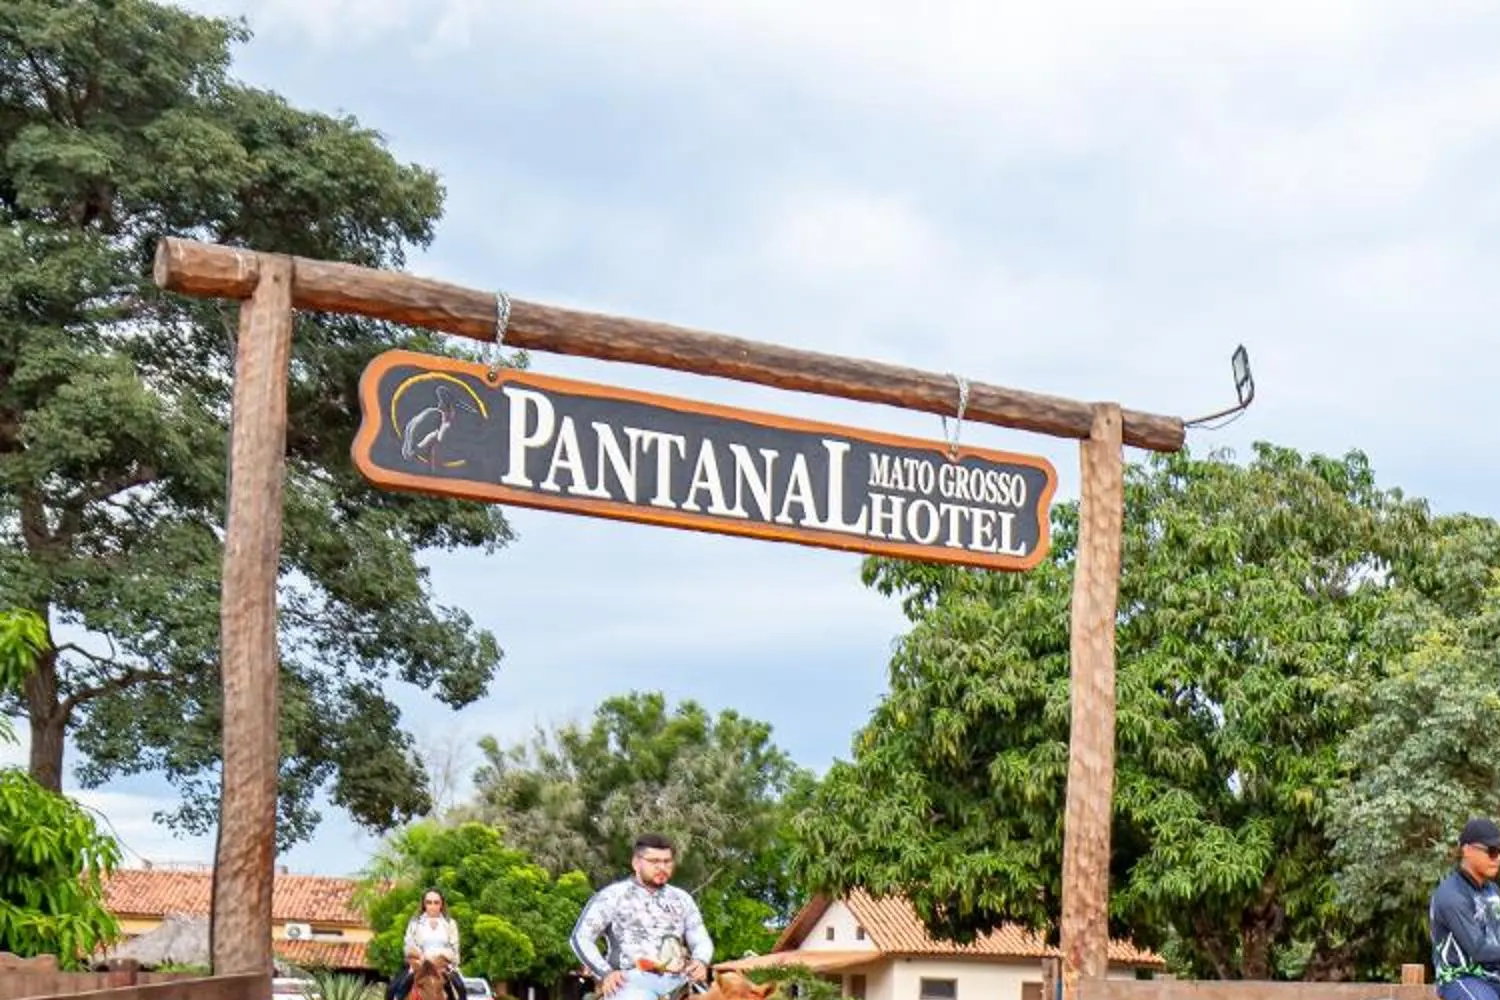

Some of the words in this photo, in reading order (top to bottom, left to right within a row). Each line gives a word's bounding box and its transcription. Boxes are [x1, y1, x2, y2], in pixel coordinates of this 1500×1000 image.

[501, 385, 868, 535] PANTANAL
[869, 452, 934, 494] MATO
[939, 463, 1027, 508] GROSSO
[868, 492, 1026, 557] HOTEL
